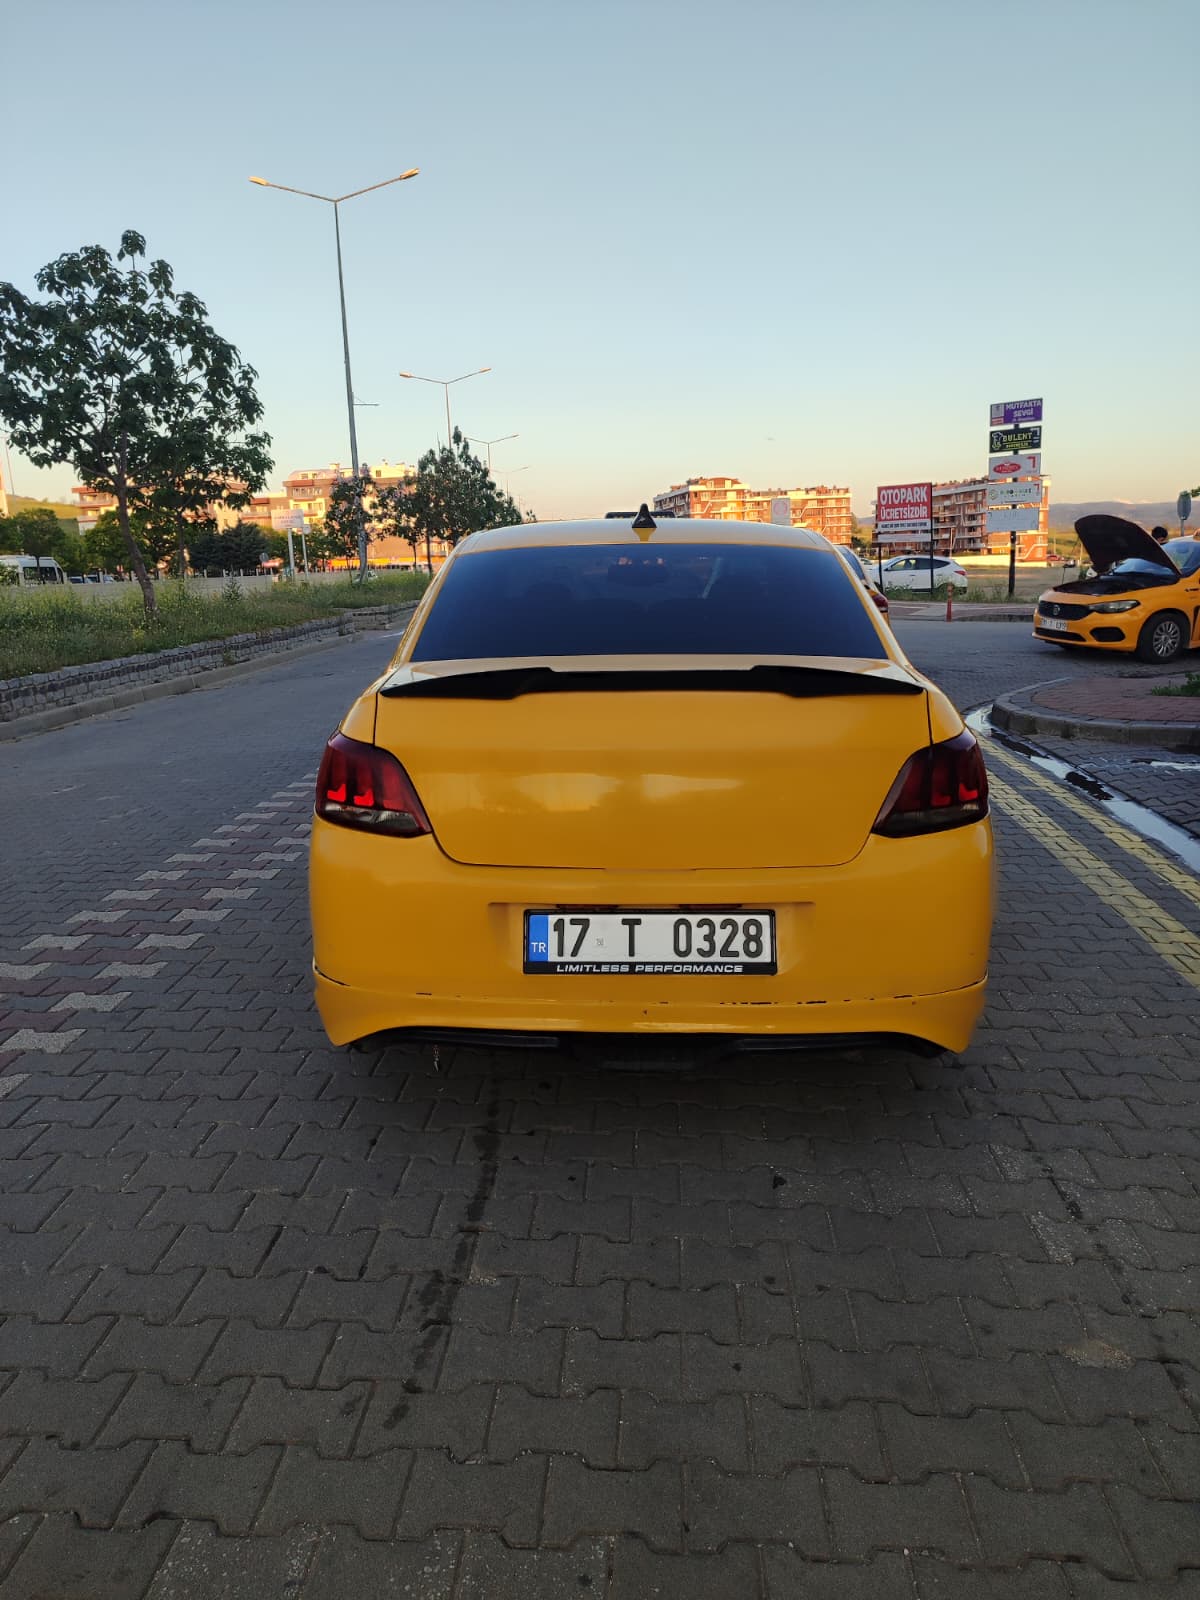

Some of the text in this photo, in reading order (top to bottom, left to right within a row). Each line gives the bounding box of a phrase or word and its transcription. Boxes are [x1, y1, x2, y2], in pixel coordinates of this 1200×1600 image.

[880, 486, 928, 505] OTOPARK
[553, 918, 763, 958] 17 T 0328
[531, 942, 546, 953] TR
[556, 964, 743, 973] LIMITLESS PERFORMANCE
